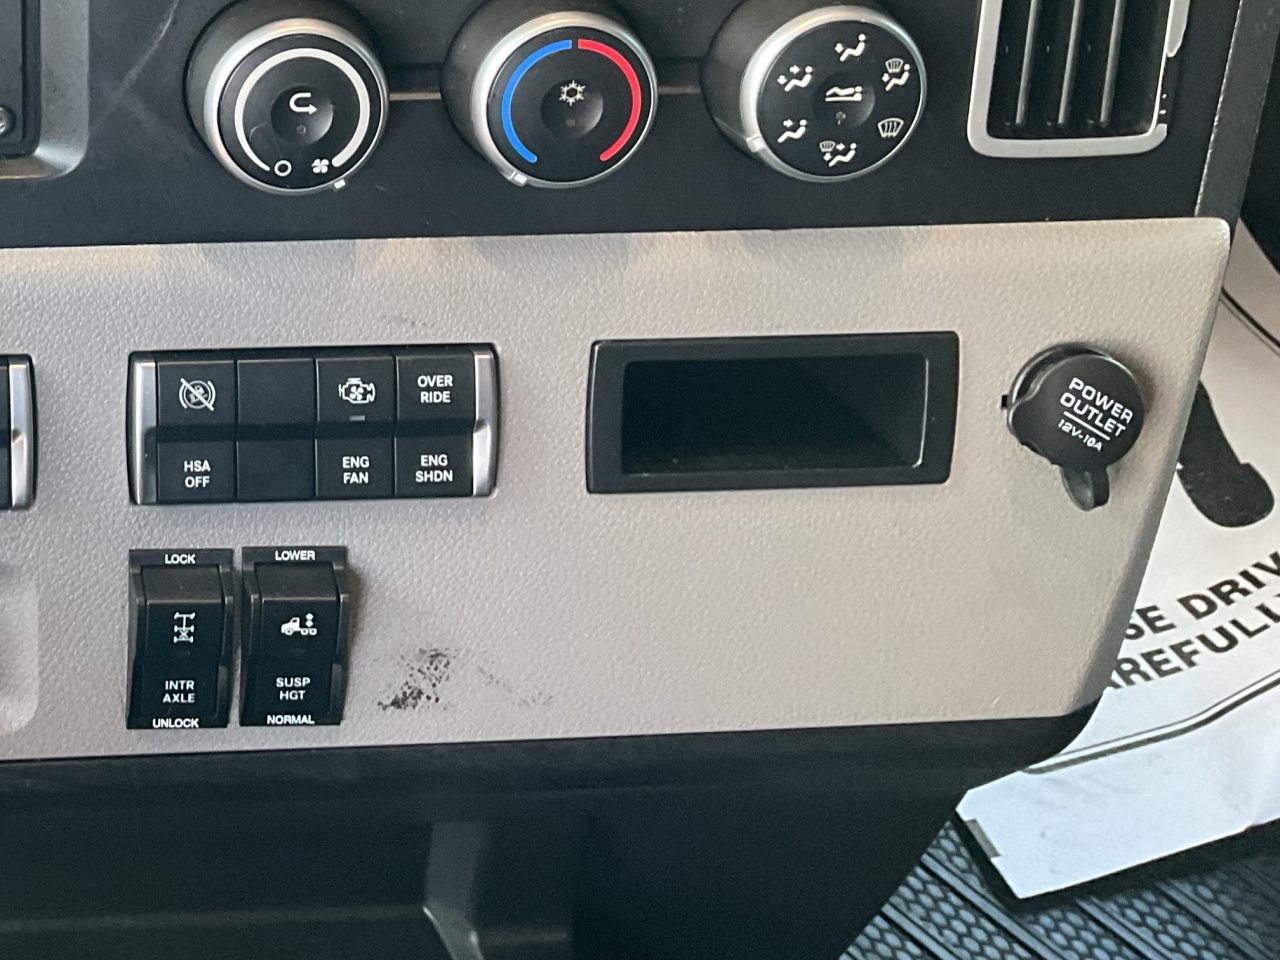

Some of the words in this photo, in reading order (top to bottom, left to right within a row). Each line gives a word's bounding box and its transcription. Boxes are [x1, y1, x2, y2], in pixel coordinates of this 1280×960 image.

[417, 375, 453, 388] OVER
[420, 391, 451, 403] RIDE
[1068, 377, 1133, 424] POWER
[1060, 392, 1126, 436] OUTLET
[1057, 419, 1103, 452] 12V-10A
[183, 460, 211, 473] HSA
[342, 456, 370, 469] ENG
[420, 454, 448, 467] ENG
[184, 475, 210, 488] OFF
[343, 472, 369, 484] FAN
[415, 469, 453, 483] SHDN
[165, 553, 196, 564] LOCK
[275, 550, 315, 561] LOWER
[165, 680, 195, 690] INTR
[276, 677, 311, 687] SUSP
[163, 693, 195, 703] AXLE
[279, 690, 306, 700] HGT
[152, 718, 199, 728] UNLOCK
[267, 715, 315, 724] NORMAL
